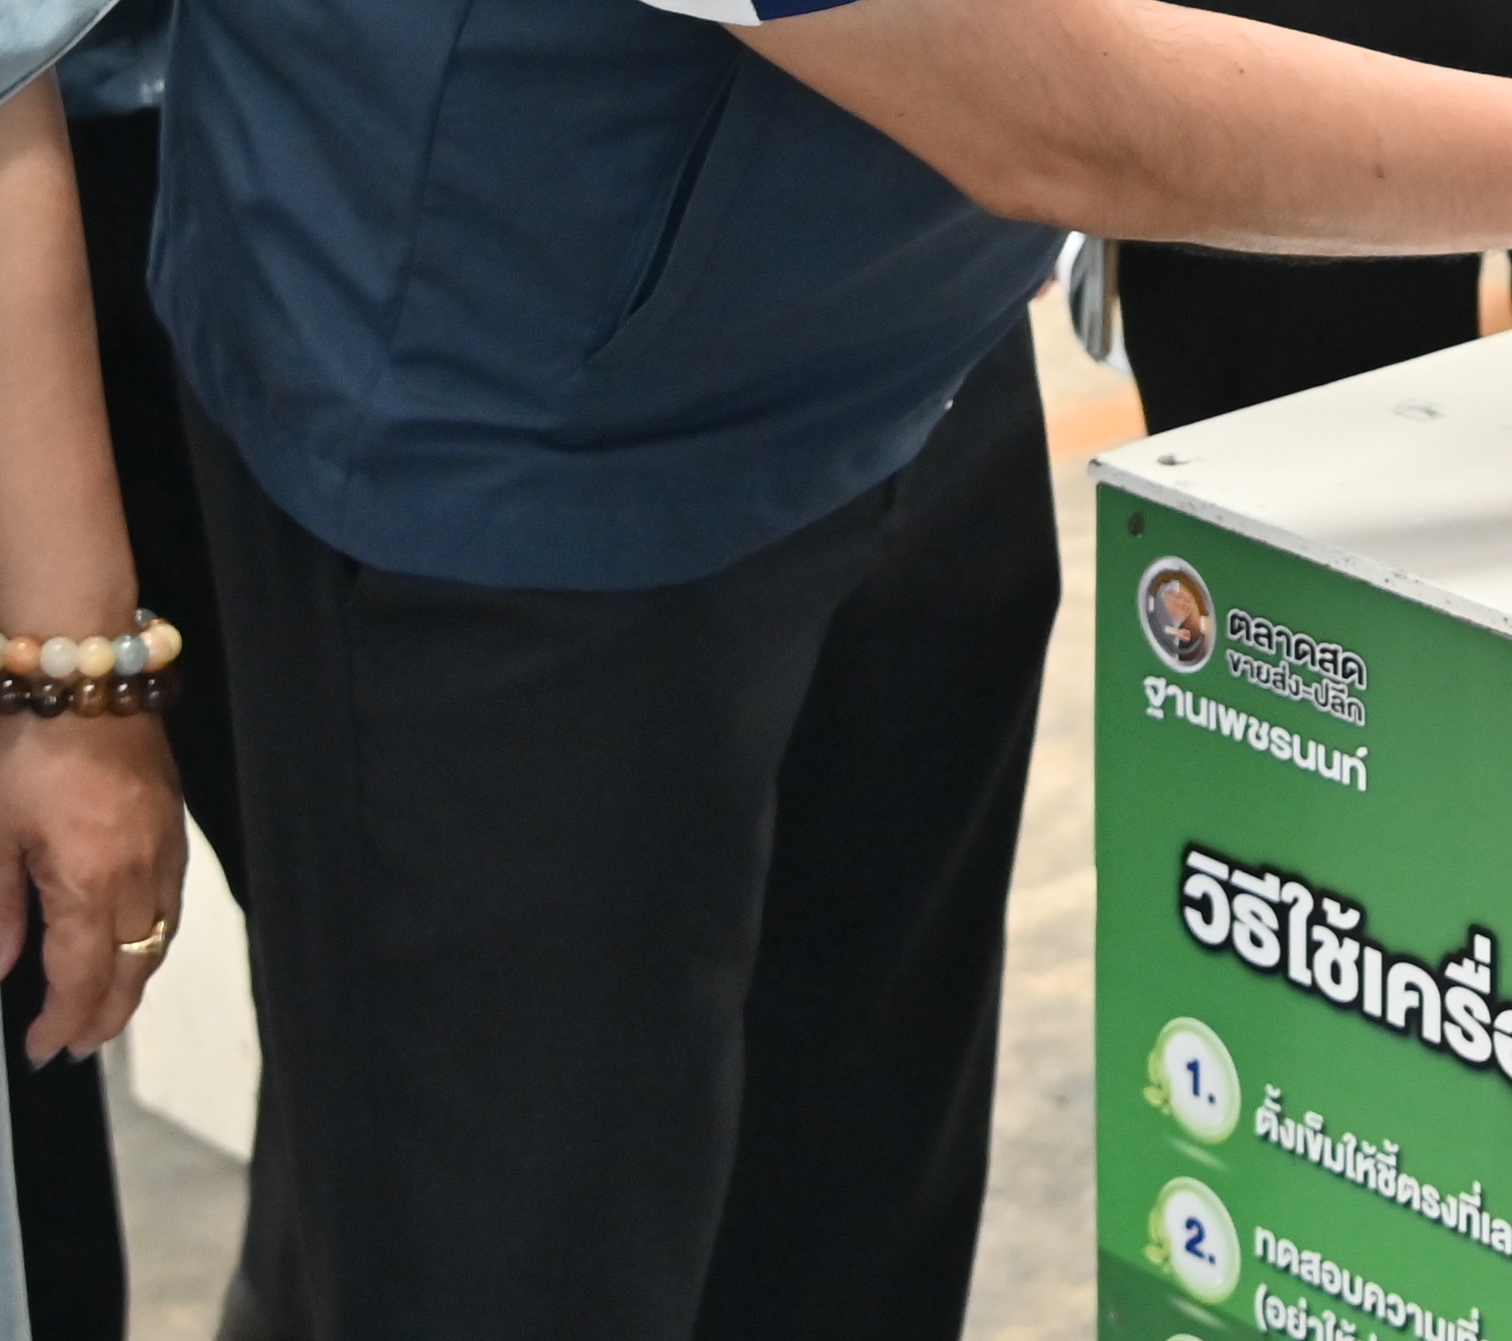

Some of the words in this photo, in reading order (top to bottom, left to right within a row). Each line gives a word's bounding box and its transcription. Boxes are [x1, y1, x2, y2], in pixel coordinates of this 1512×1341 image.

[1225, 647, 1367, 725] ขายส่ง-ปลีก
[1226, 606, 1368, 689] ตลาดสด
[1142, 672, 1368, 793] ฐานเพชรนนท์
[1184, 1058, 1217, 1104] 1.
[1184, 1217, 1217, 1266] 2.
